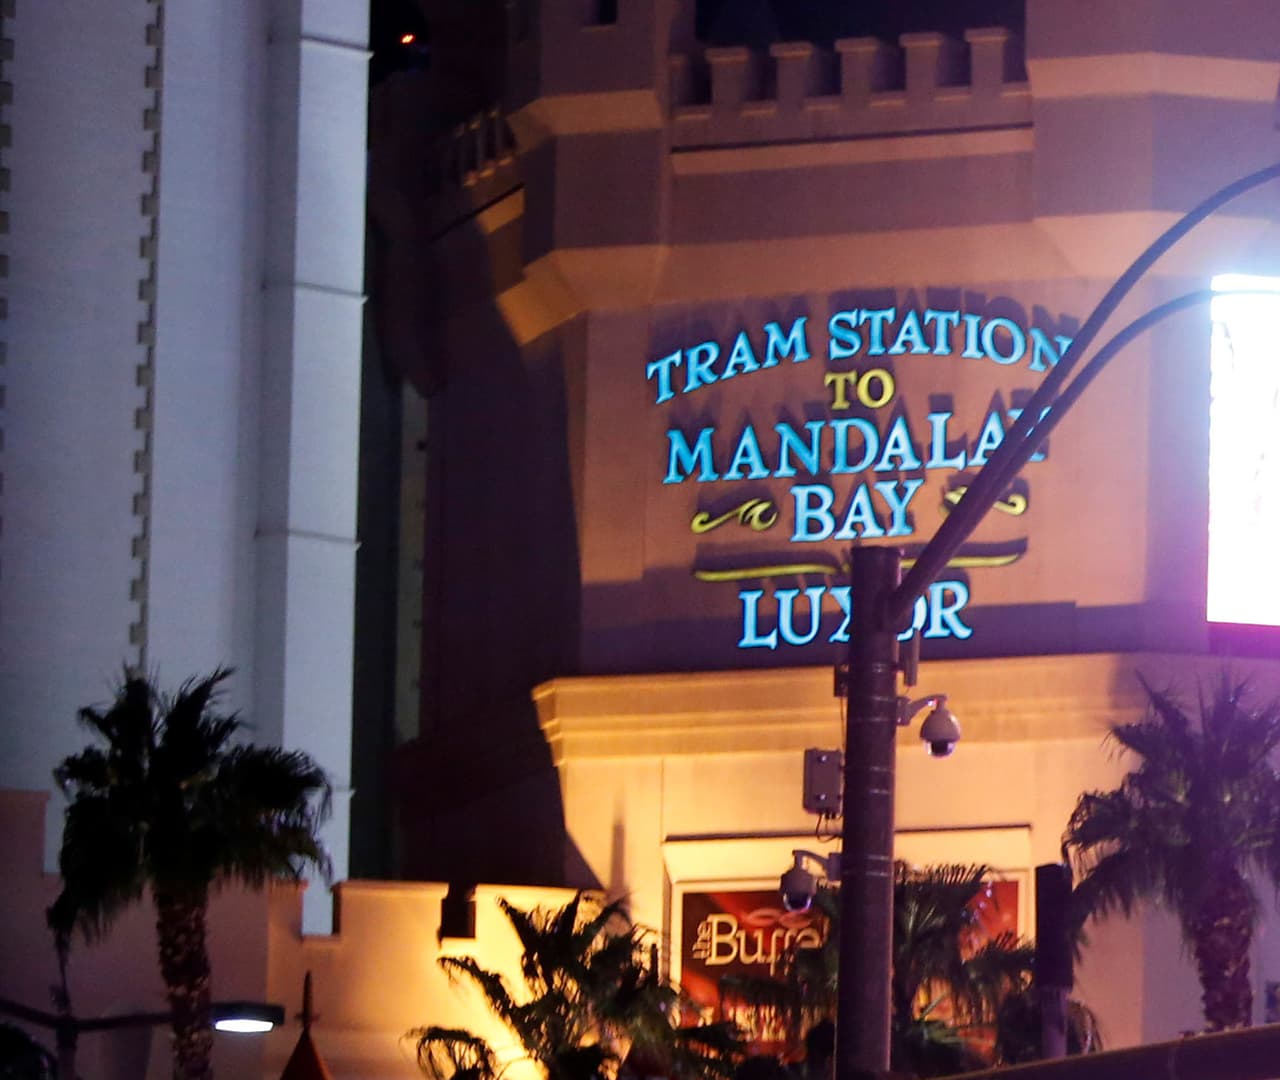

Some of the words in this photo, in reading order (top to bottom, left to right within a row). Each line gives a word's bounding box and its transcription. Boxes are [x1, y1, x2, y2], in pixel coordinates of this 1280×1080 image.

[646, 316, 810, 405] TRAM
[828, 306, 1074, 374] STATION
[823, 367, 896, 411] TO
[661, 404, 1053, 485] MANDALA
[789, 477, 925, 543] BAY
